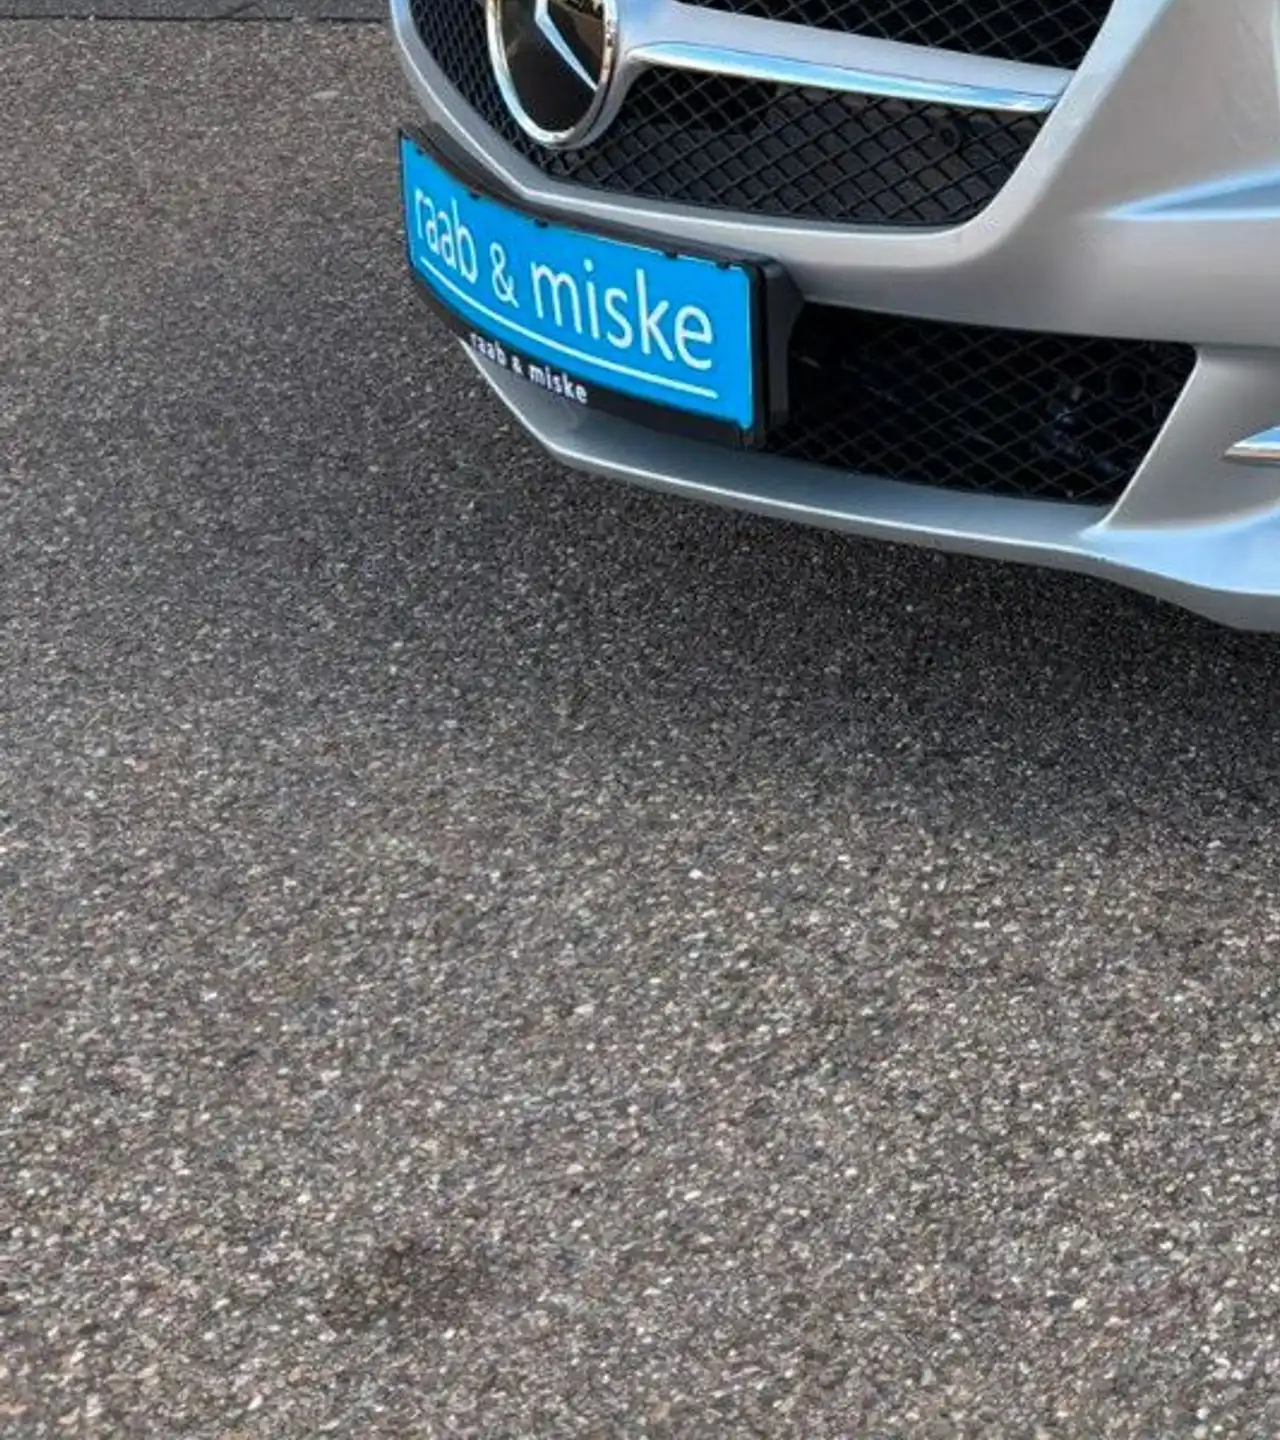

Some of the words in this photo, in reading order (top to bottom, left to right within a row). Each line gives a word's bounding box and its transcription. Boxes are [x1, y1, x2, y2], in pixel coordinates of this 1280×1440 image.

[414, 188, 478, 284] raab
[490, 242, 520, 308] &
[530, 258, 713, 371] miske
[470, 332, 507, 366] raab
[511, 355, 523, 376] &
[529, 363, 588, 405] miske
